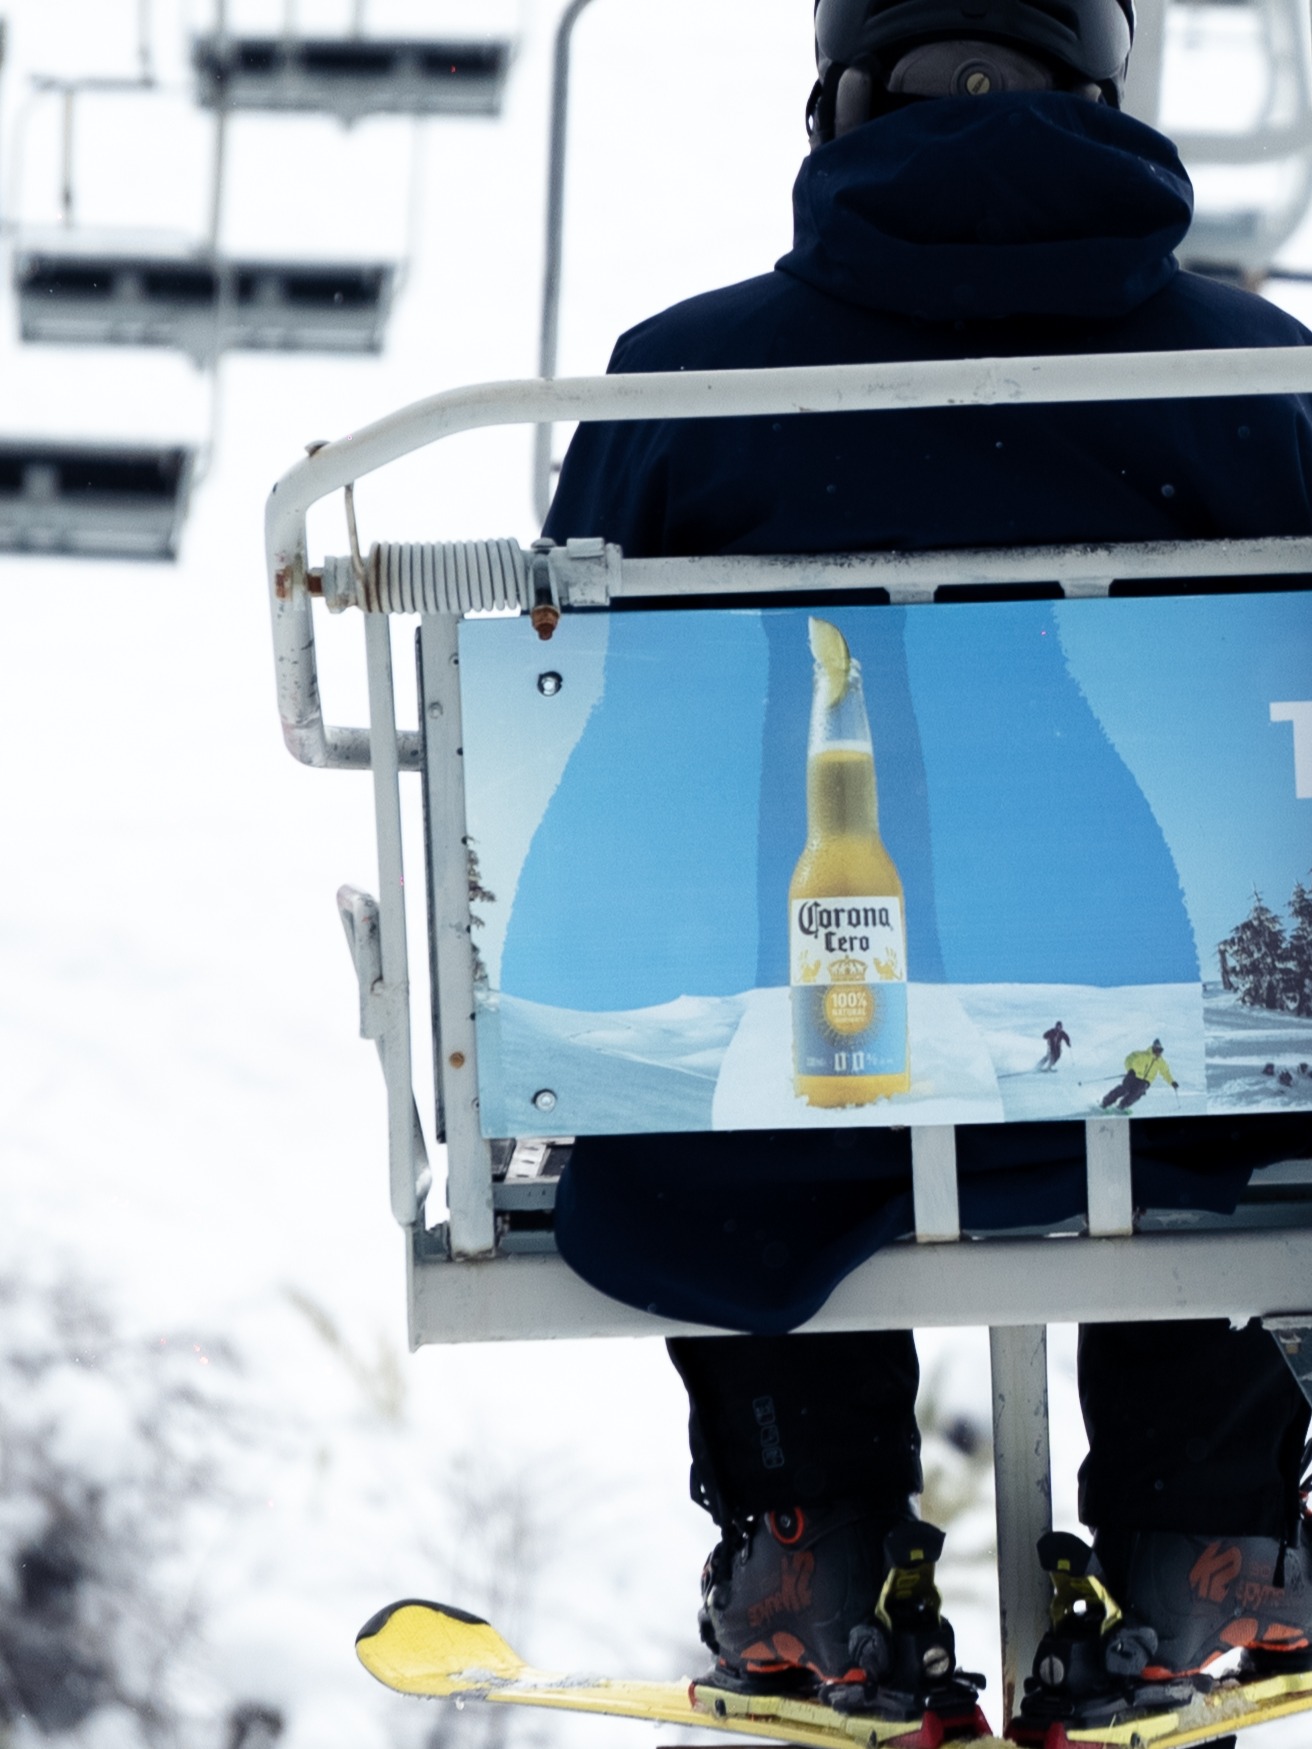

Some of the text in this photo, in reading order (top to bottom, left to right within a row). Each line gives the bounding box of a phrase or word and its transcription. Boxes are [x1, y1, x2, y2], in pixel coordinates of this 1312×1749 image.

[798, 901, 891, 939] Corona
[825, 931, 870, 953] Cero
[832, 992, 868, 1008] 100%
